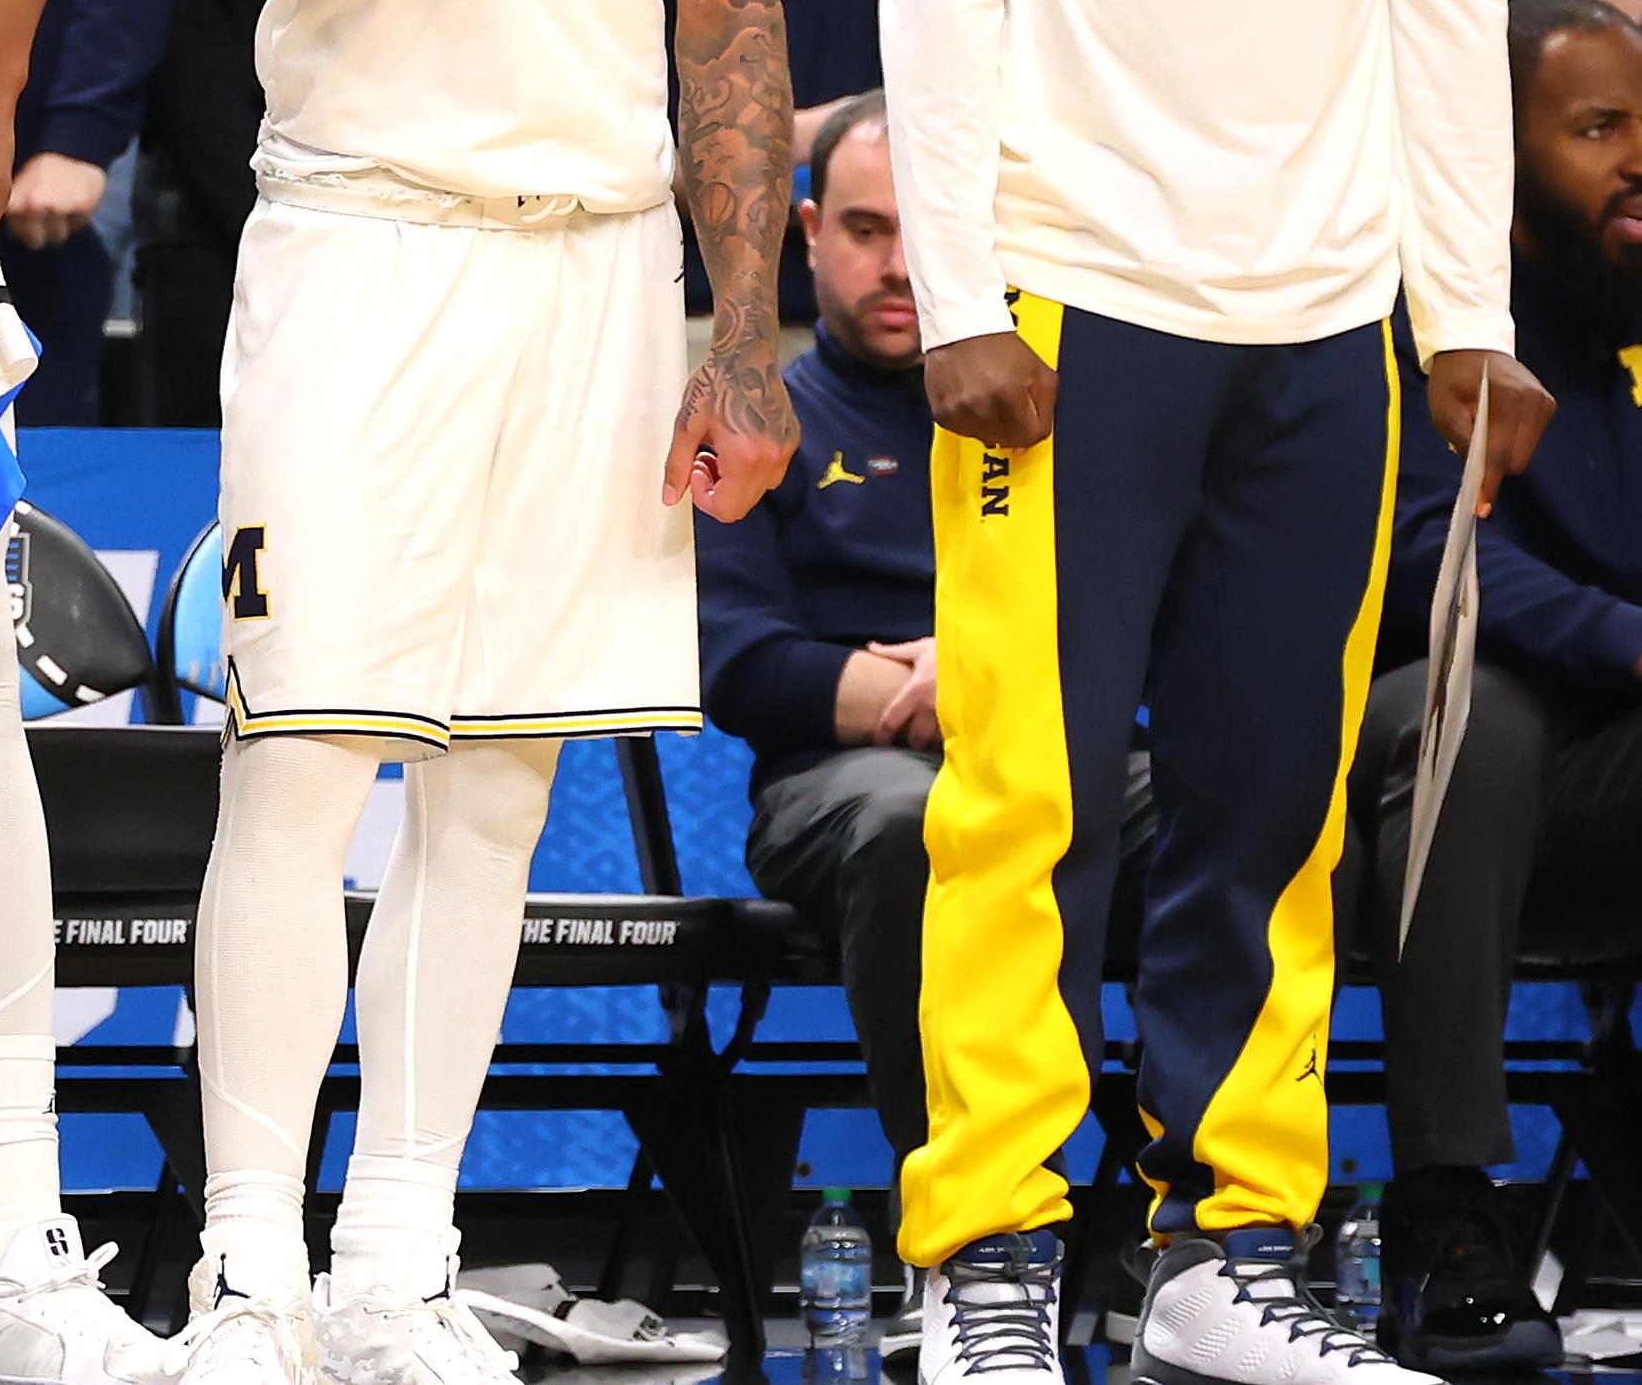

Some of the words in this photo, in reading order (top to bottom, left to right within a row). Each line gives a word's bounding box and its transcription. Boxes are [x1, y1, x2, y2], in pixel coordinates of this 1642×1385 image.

[65, 919, 126, 945] FINAL
[130, 919, 188, 945] FOUR
[555, 918, 614, 945] FINAL
[619, 920, 677, 945] FOUR
